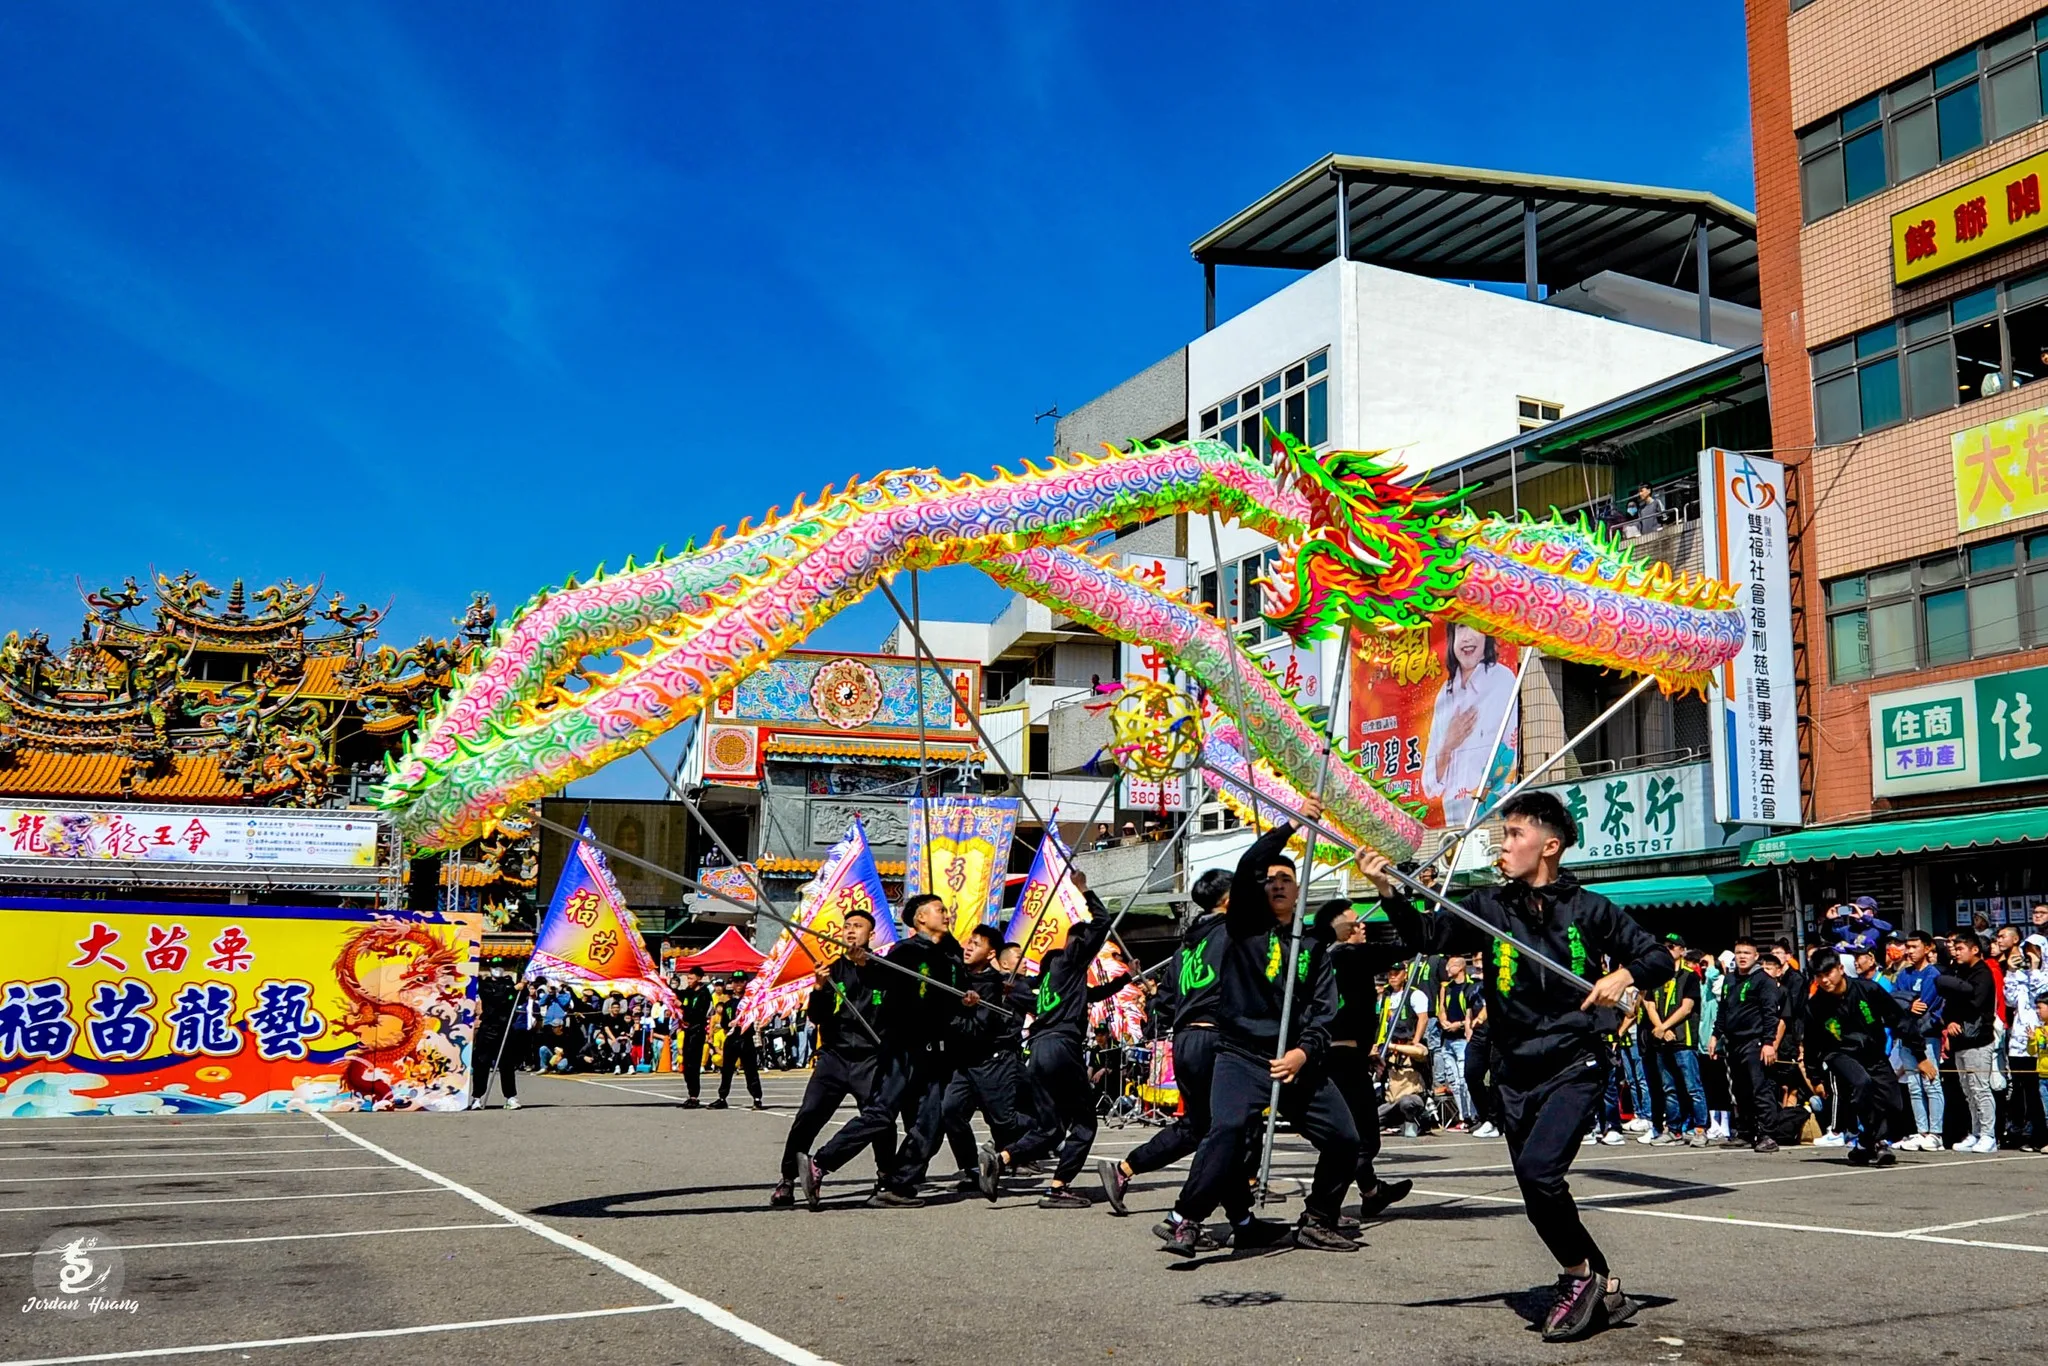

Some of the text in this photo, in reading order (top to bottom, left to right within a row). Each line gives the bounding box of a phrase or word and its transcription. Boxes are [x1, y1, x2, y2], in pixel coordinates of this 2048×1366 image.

[1747, 513, 1776, 820] 雙福社會福利慈善事業基金會
[1892, 705, 1952, 742] 住商
[1991, 692, 2042, 761] 住
[1361, 737, 1421, 778] 鄭碧玉
[1896, 745, 1954, 770] 不動產
[1131, 791, 1181, 806] 38080
[0, 813, 49, 852] 龍
[1603, 838, 1674, 857] 265797
[68, 922, 254, 973] 大苗栗
[0, 981, 324, 1058] 福苗龍藝
